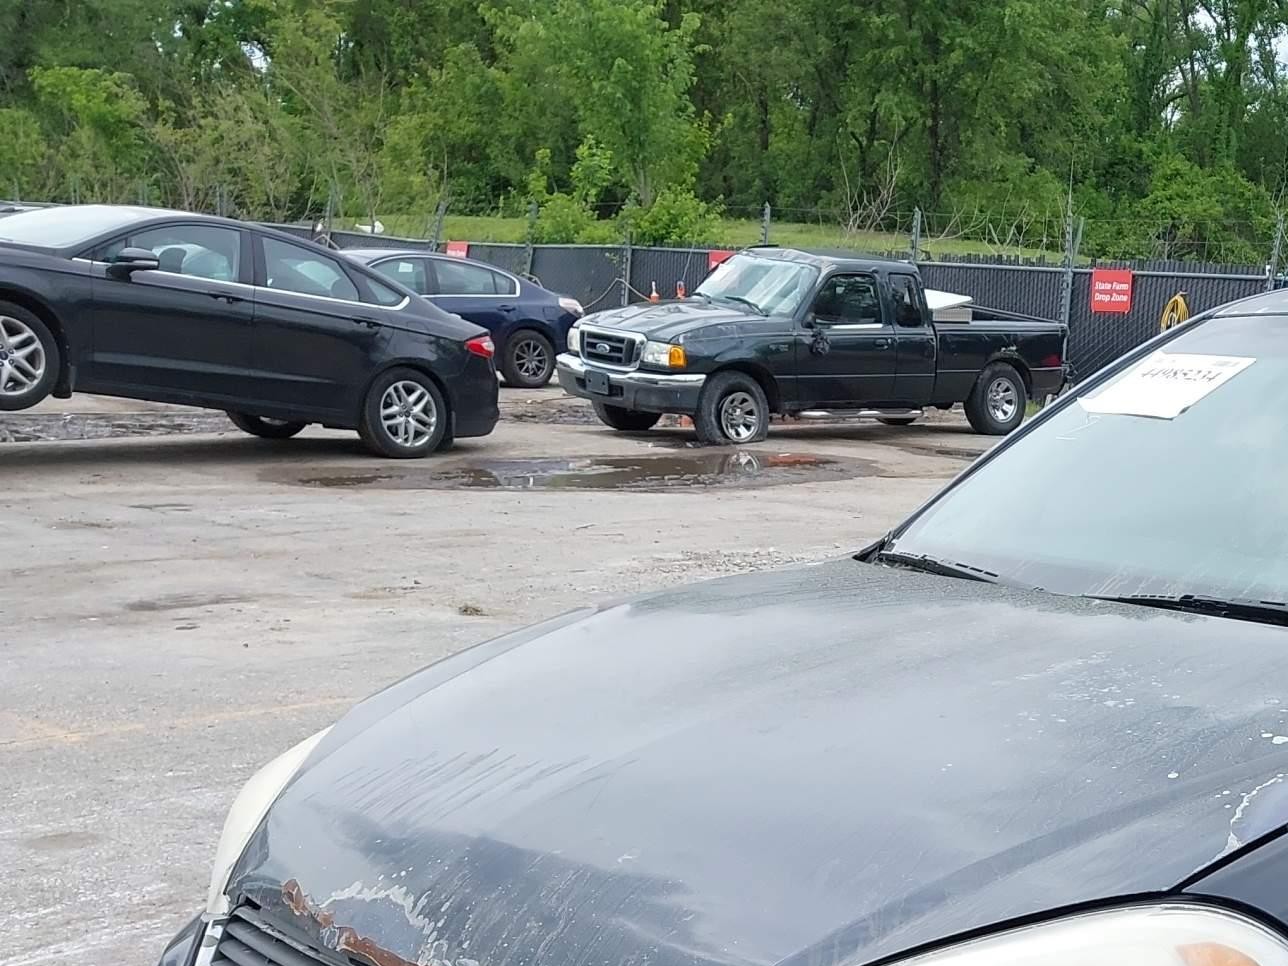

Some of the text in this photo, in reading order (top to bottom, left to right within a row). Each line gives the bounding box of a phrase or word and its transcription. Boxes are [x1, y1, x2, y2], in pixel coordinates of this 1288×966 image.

[1094, 281, 1129, 290] State Farm
[1094, 292, 1128, 302] Drop Zone
